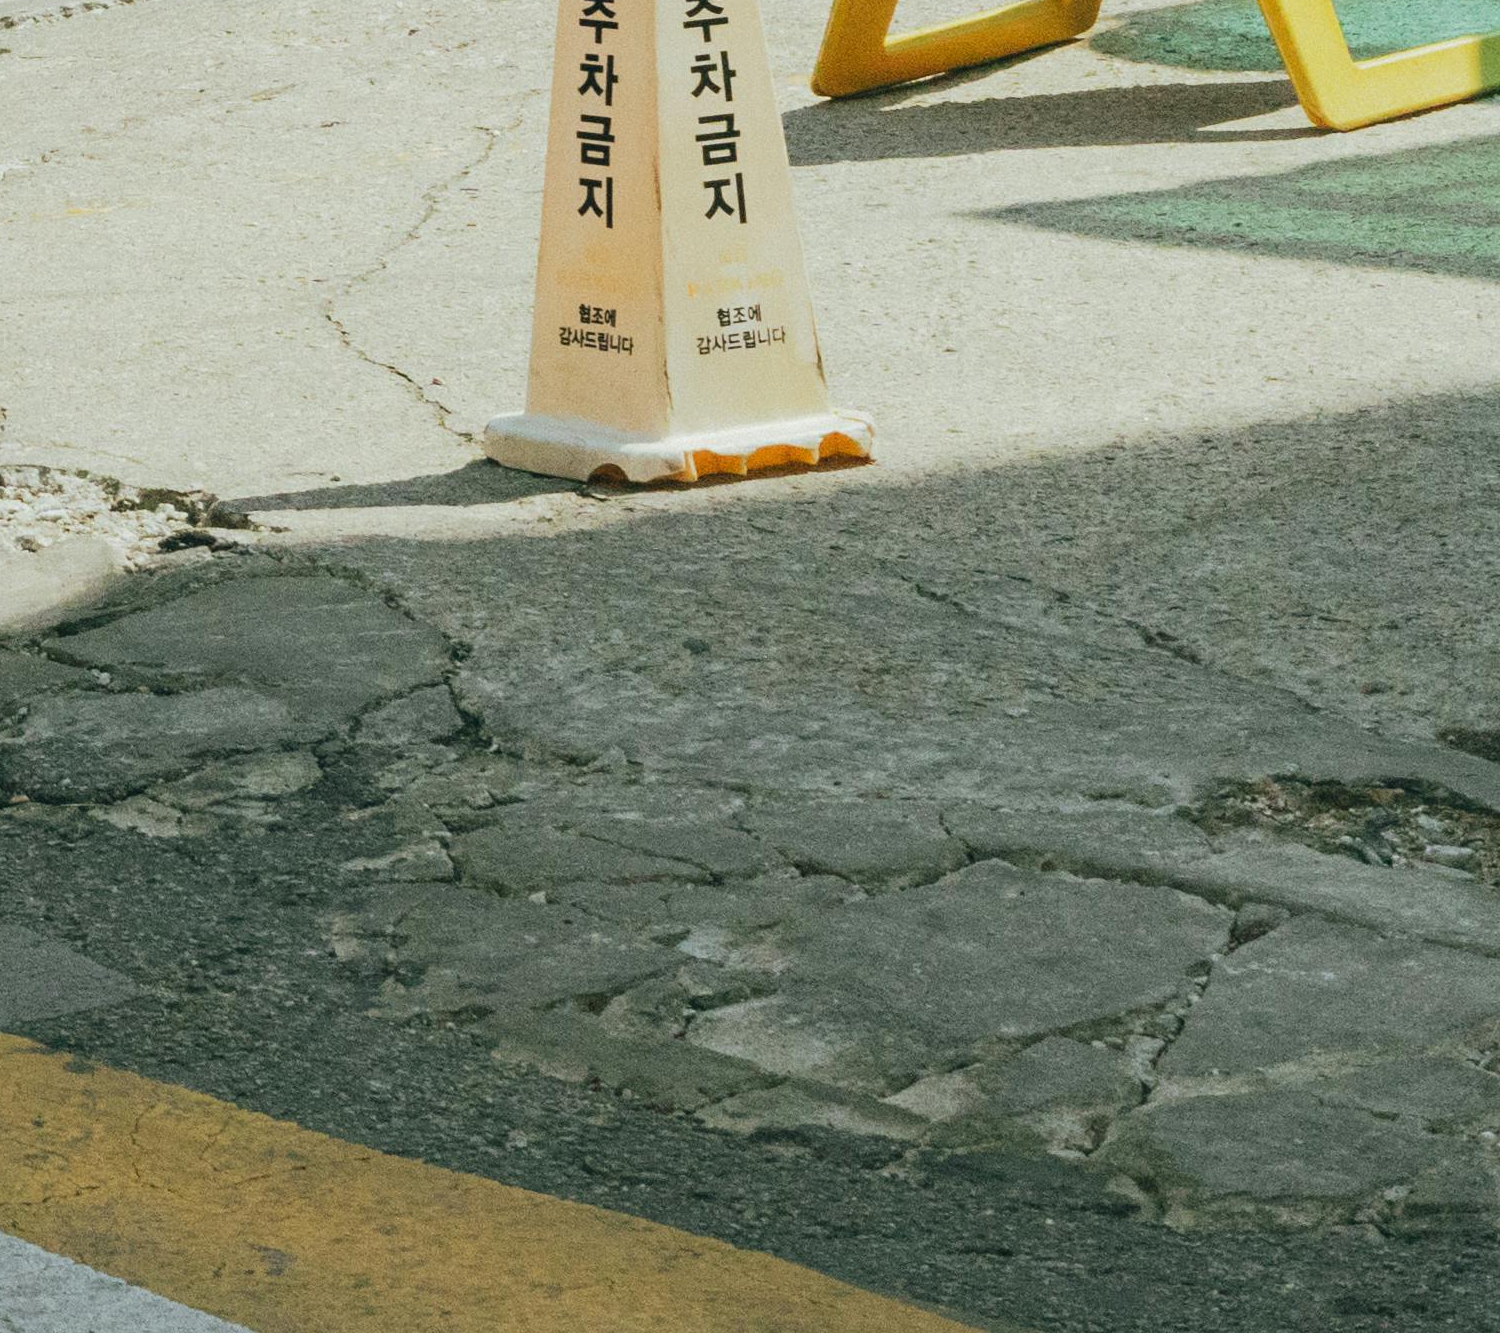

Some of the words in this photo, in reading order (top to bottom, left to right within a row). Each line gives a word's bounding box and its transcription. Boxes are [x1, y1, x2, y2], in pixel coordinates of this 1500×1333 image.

[579, 304, 616, 327] 협조에
[717, 305, 761, 327] 협조에
[559, 327, 633, 355] 감사드립니다
[696, 326, 786, 355] 감사드립니다
